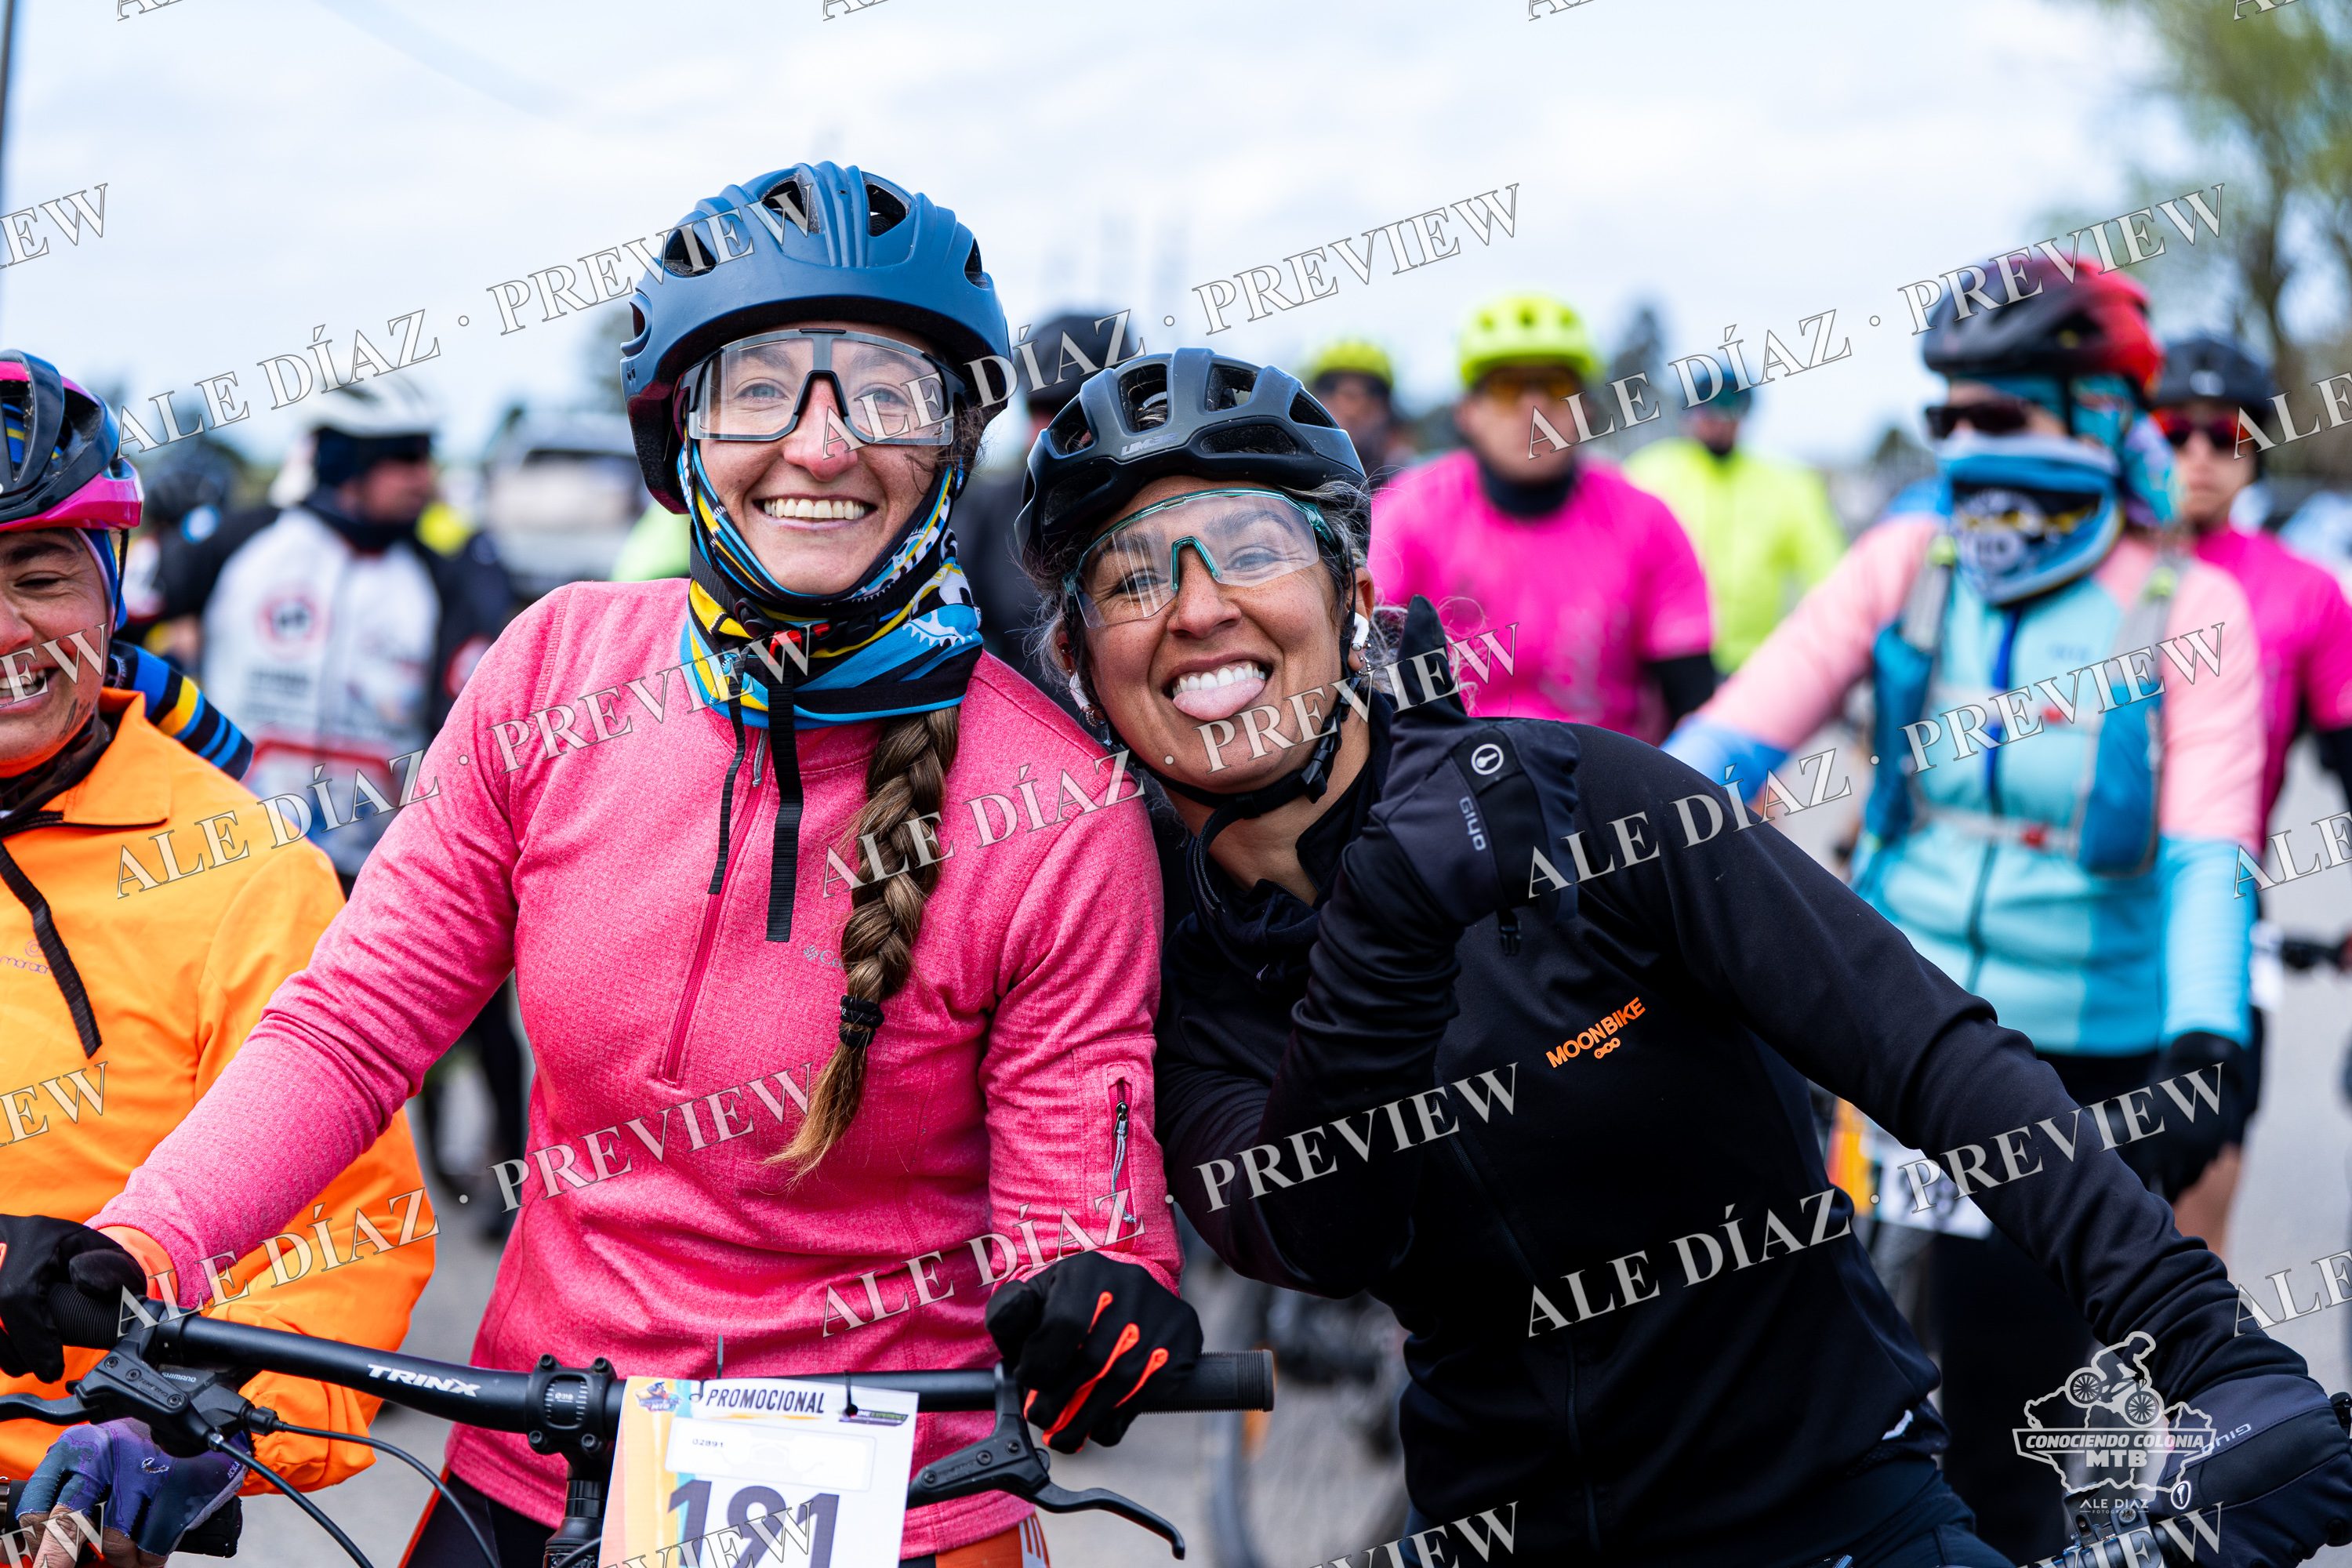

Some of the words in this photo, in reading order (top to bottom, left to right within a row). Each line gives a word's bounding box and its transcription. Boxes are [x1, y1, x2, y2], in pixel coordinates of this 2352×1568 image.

[1545, 996, 1646, 1068] MOONBIKE
[162, 1372, 196, 1383] SHIMANO
[368, 1364, 481, 1398] TRINX
[705, 1388, 825, 1414] PROMOCIONAL
